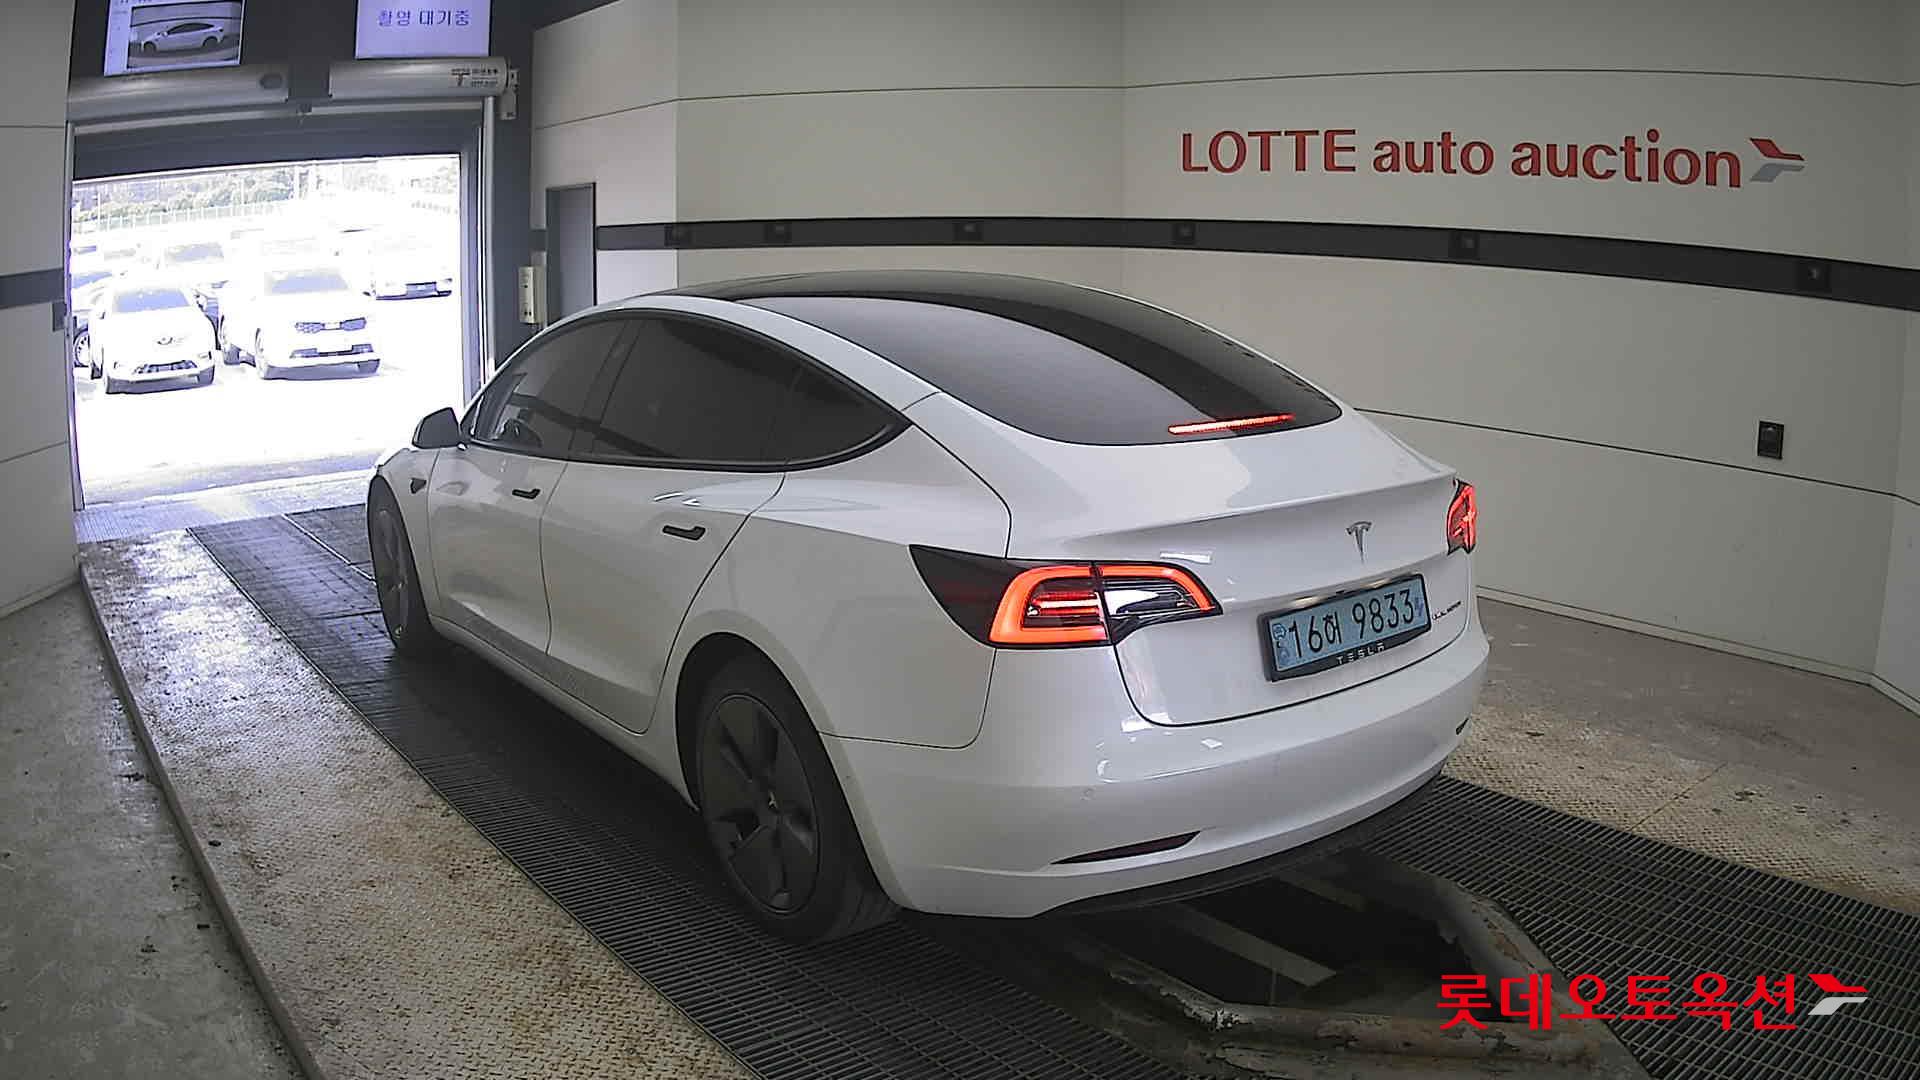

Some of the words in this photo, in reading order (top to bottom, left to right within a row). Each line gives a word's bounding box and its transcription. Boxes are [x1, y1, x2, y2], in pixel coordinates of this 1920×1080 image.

[418, 9, 470, 26] 대기중
[1182, 129, 1357, 174] LOTTE
[1372, 131, 1495, 175] auto
[1511, 129, 1742, 188] auction
[1288, 611, 1342, 658] 16허
[1351, 588, 1414, 640] 9833
[1335, 641, 1386, 665] TESLA
